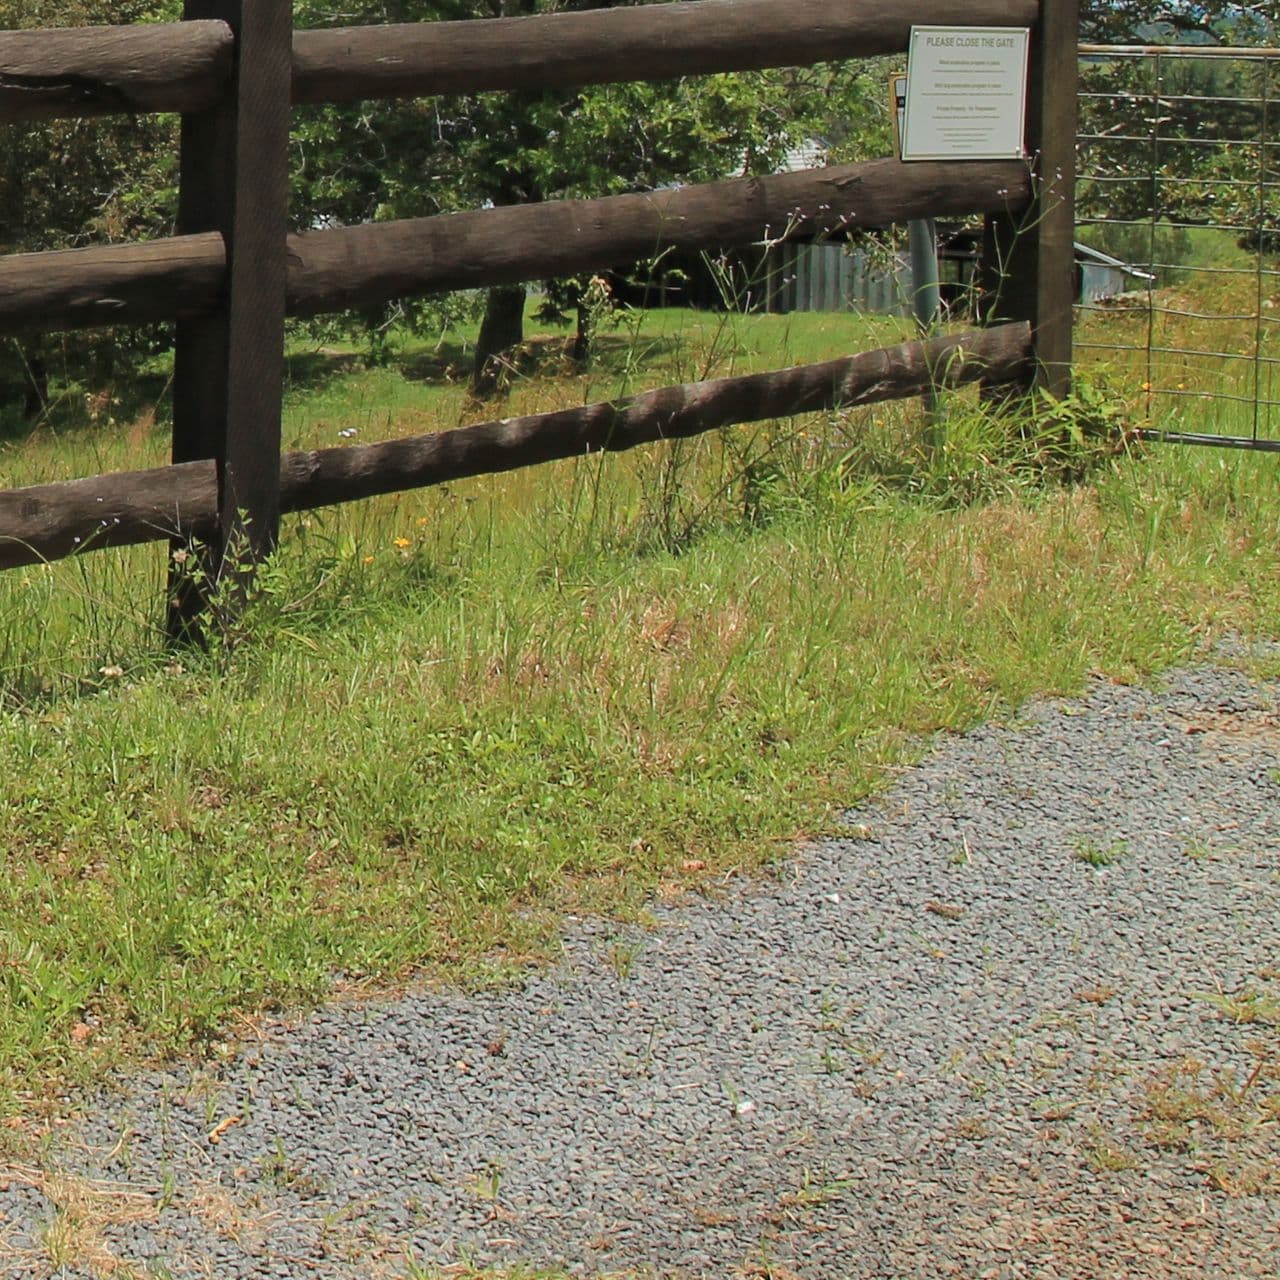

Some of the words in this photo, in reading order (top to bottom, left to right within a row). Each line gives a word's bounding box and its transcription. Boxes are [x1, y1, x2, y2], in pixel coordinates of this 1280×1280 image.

[926, 36, 954, 47] PLEASE
[956, 37, 980, 47] CLOSE
[981, 37, 995, 47] THE
[996, 37, 1015, 48] GATE
